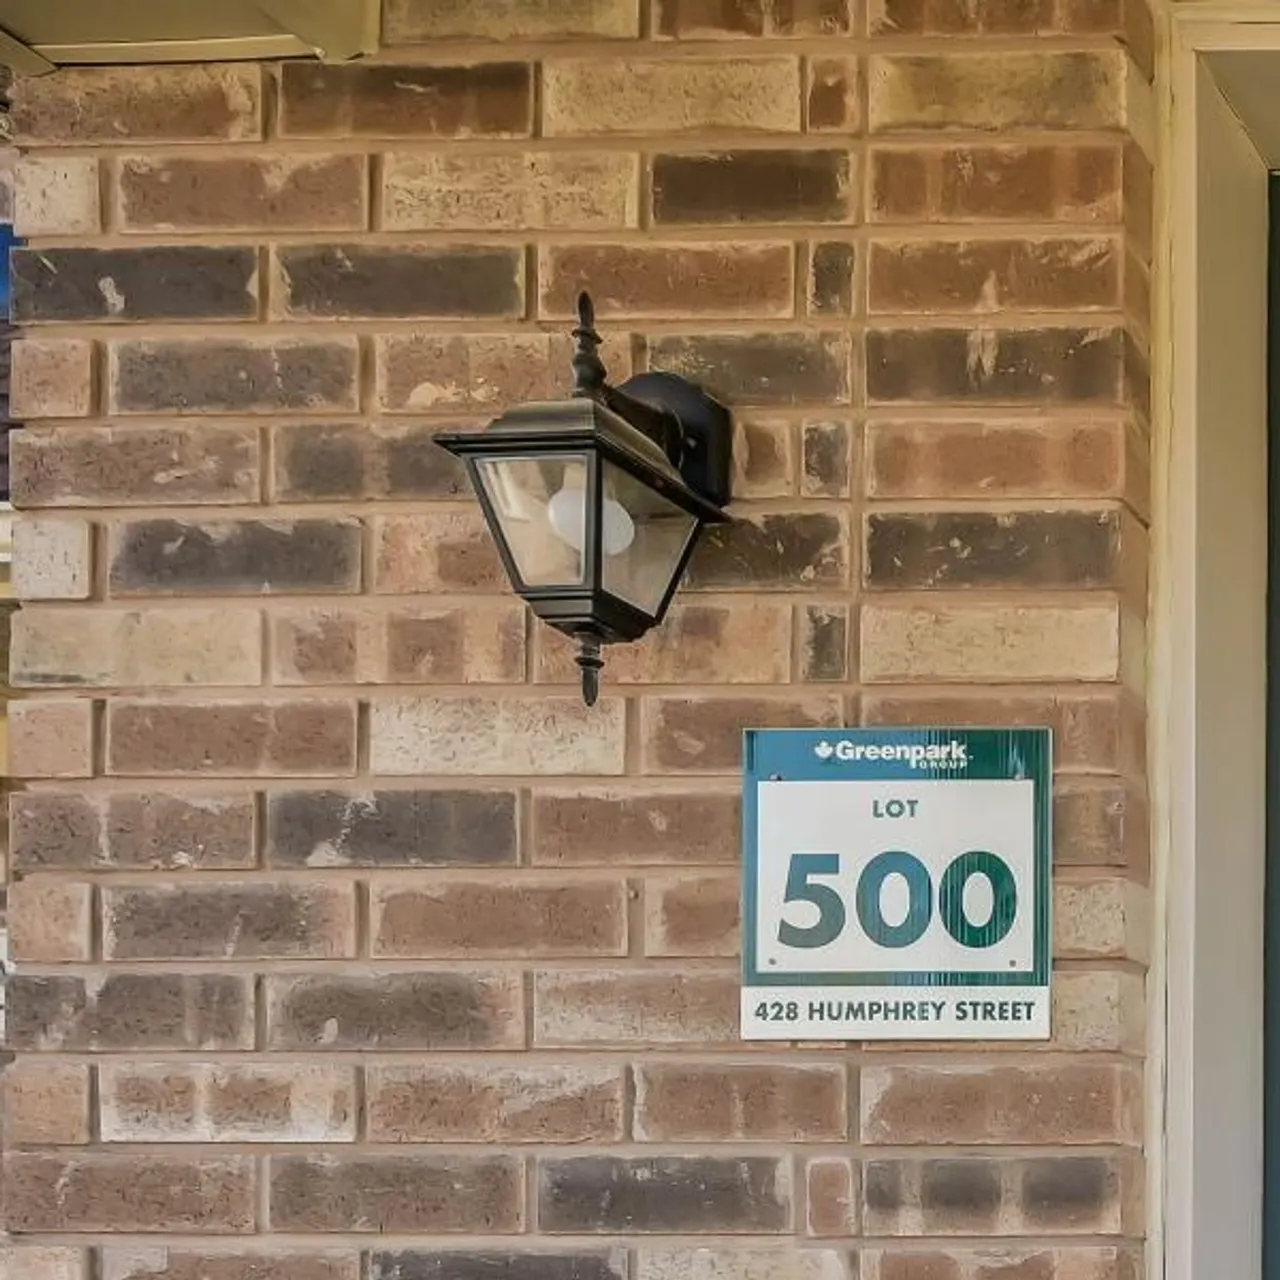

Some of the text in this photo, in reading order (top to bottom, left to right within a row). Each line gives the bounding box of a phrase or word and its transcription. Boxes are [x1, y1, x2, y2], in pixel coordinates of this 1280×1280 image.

[835, 740, 967, 769] Greenpark
[872, 800, 919, 818] LOT
[777, 850, 1018, 949] 500
[754, 1000, 1035, 1021] 428 HUMPHREY STREET
